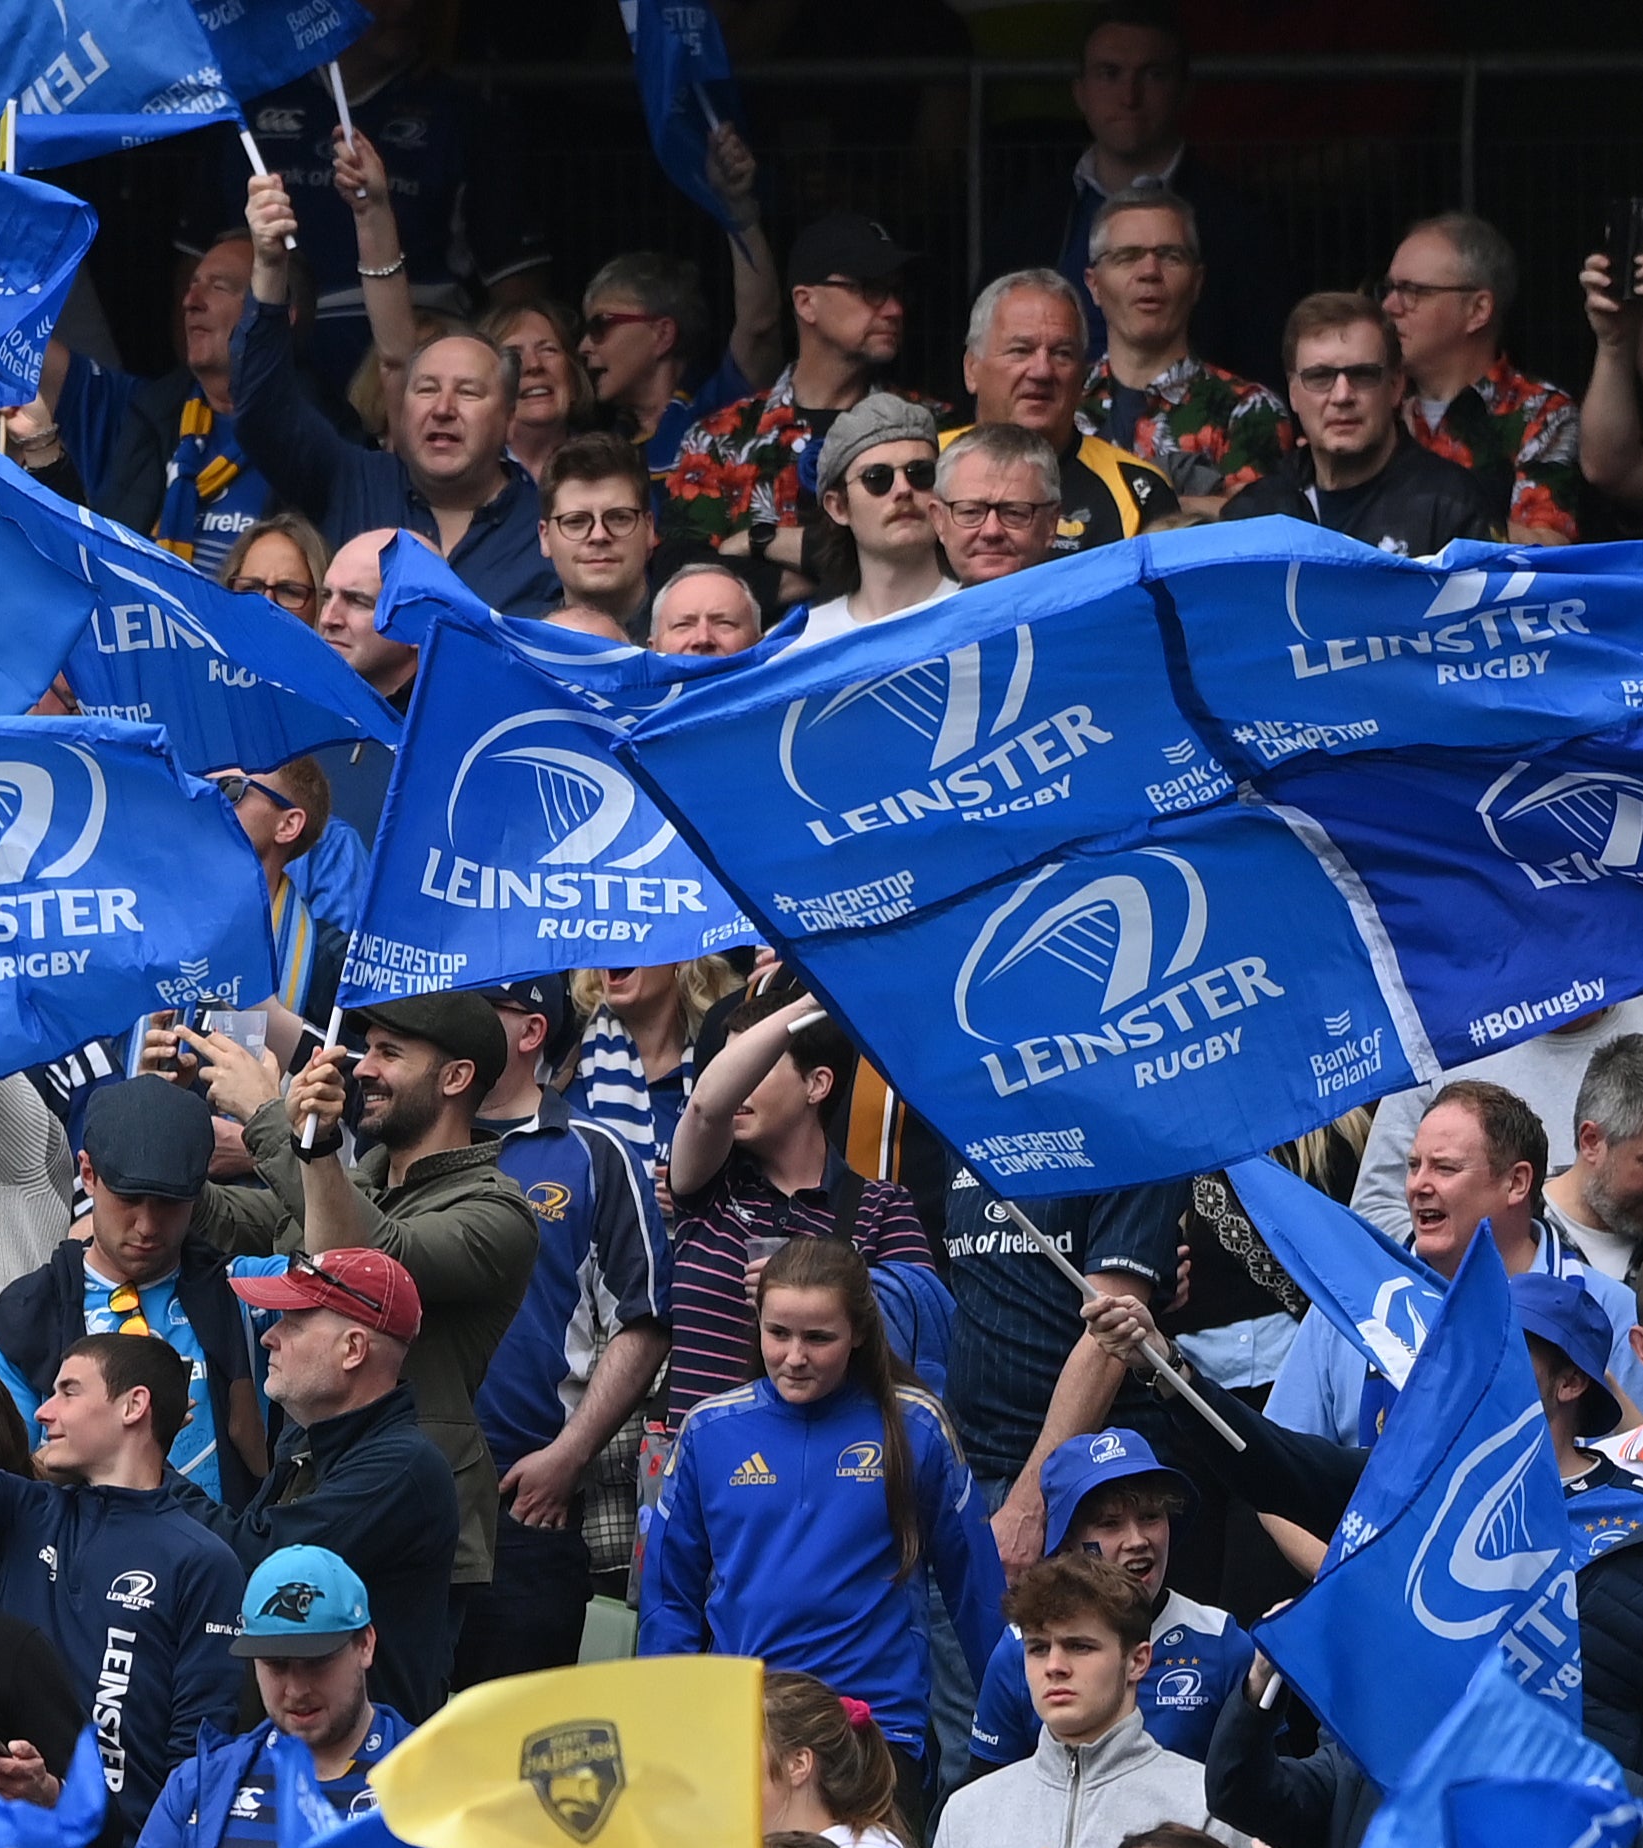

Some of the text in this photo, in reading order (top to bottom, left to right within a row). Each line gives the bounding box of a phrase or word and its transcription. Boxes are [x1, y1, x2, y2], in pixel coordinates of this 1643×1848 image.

[1287, 597, 1590, 680] LEINSTER
[1437, 649, 1550, 686] RUGBY
[804, 703, 1114, 845] LEINSTER
[1145, 766, 1205, 804] Bank
[960, 774, 1072, 822] RUGBY
[420, 846, 708, 914] LEINSTER
[537, 917, 653, 943] RUGBY
[978, 955, 1285, 1098] LEINSTER
[1468, 976, 1607, 1048] #BOIrugby
[1133, 1026, 1243, 1090] RUGBY
[1310, 1028, 1383, 1078] Bank of
[1315, 1053, 1383, 1099] Ireland
[965, 1126, 1086, 1163] #NEVERSTOP
[990, 1148, 1094, 1180] COMPETING
[975, 1230, 996, 1254] of
[728, 1474, 777, 1487] adidas
[836, 1467, 884, 1478] LEINSTER
[106, 1591, 155, 1609] LEINSTER
[206, 1622, 232, 1635] Bank
[1156, 1695, 1203, 1706] LEINSTER
